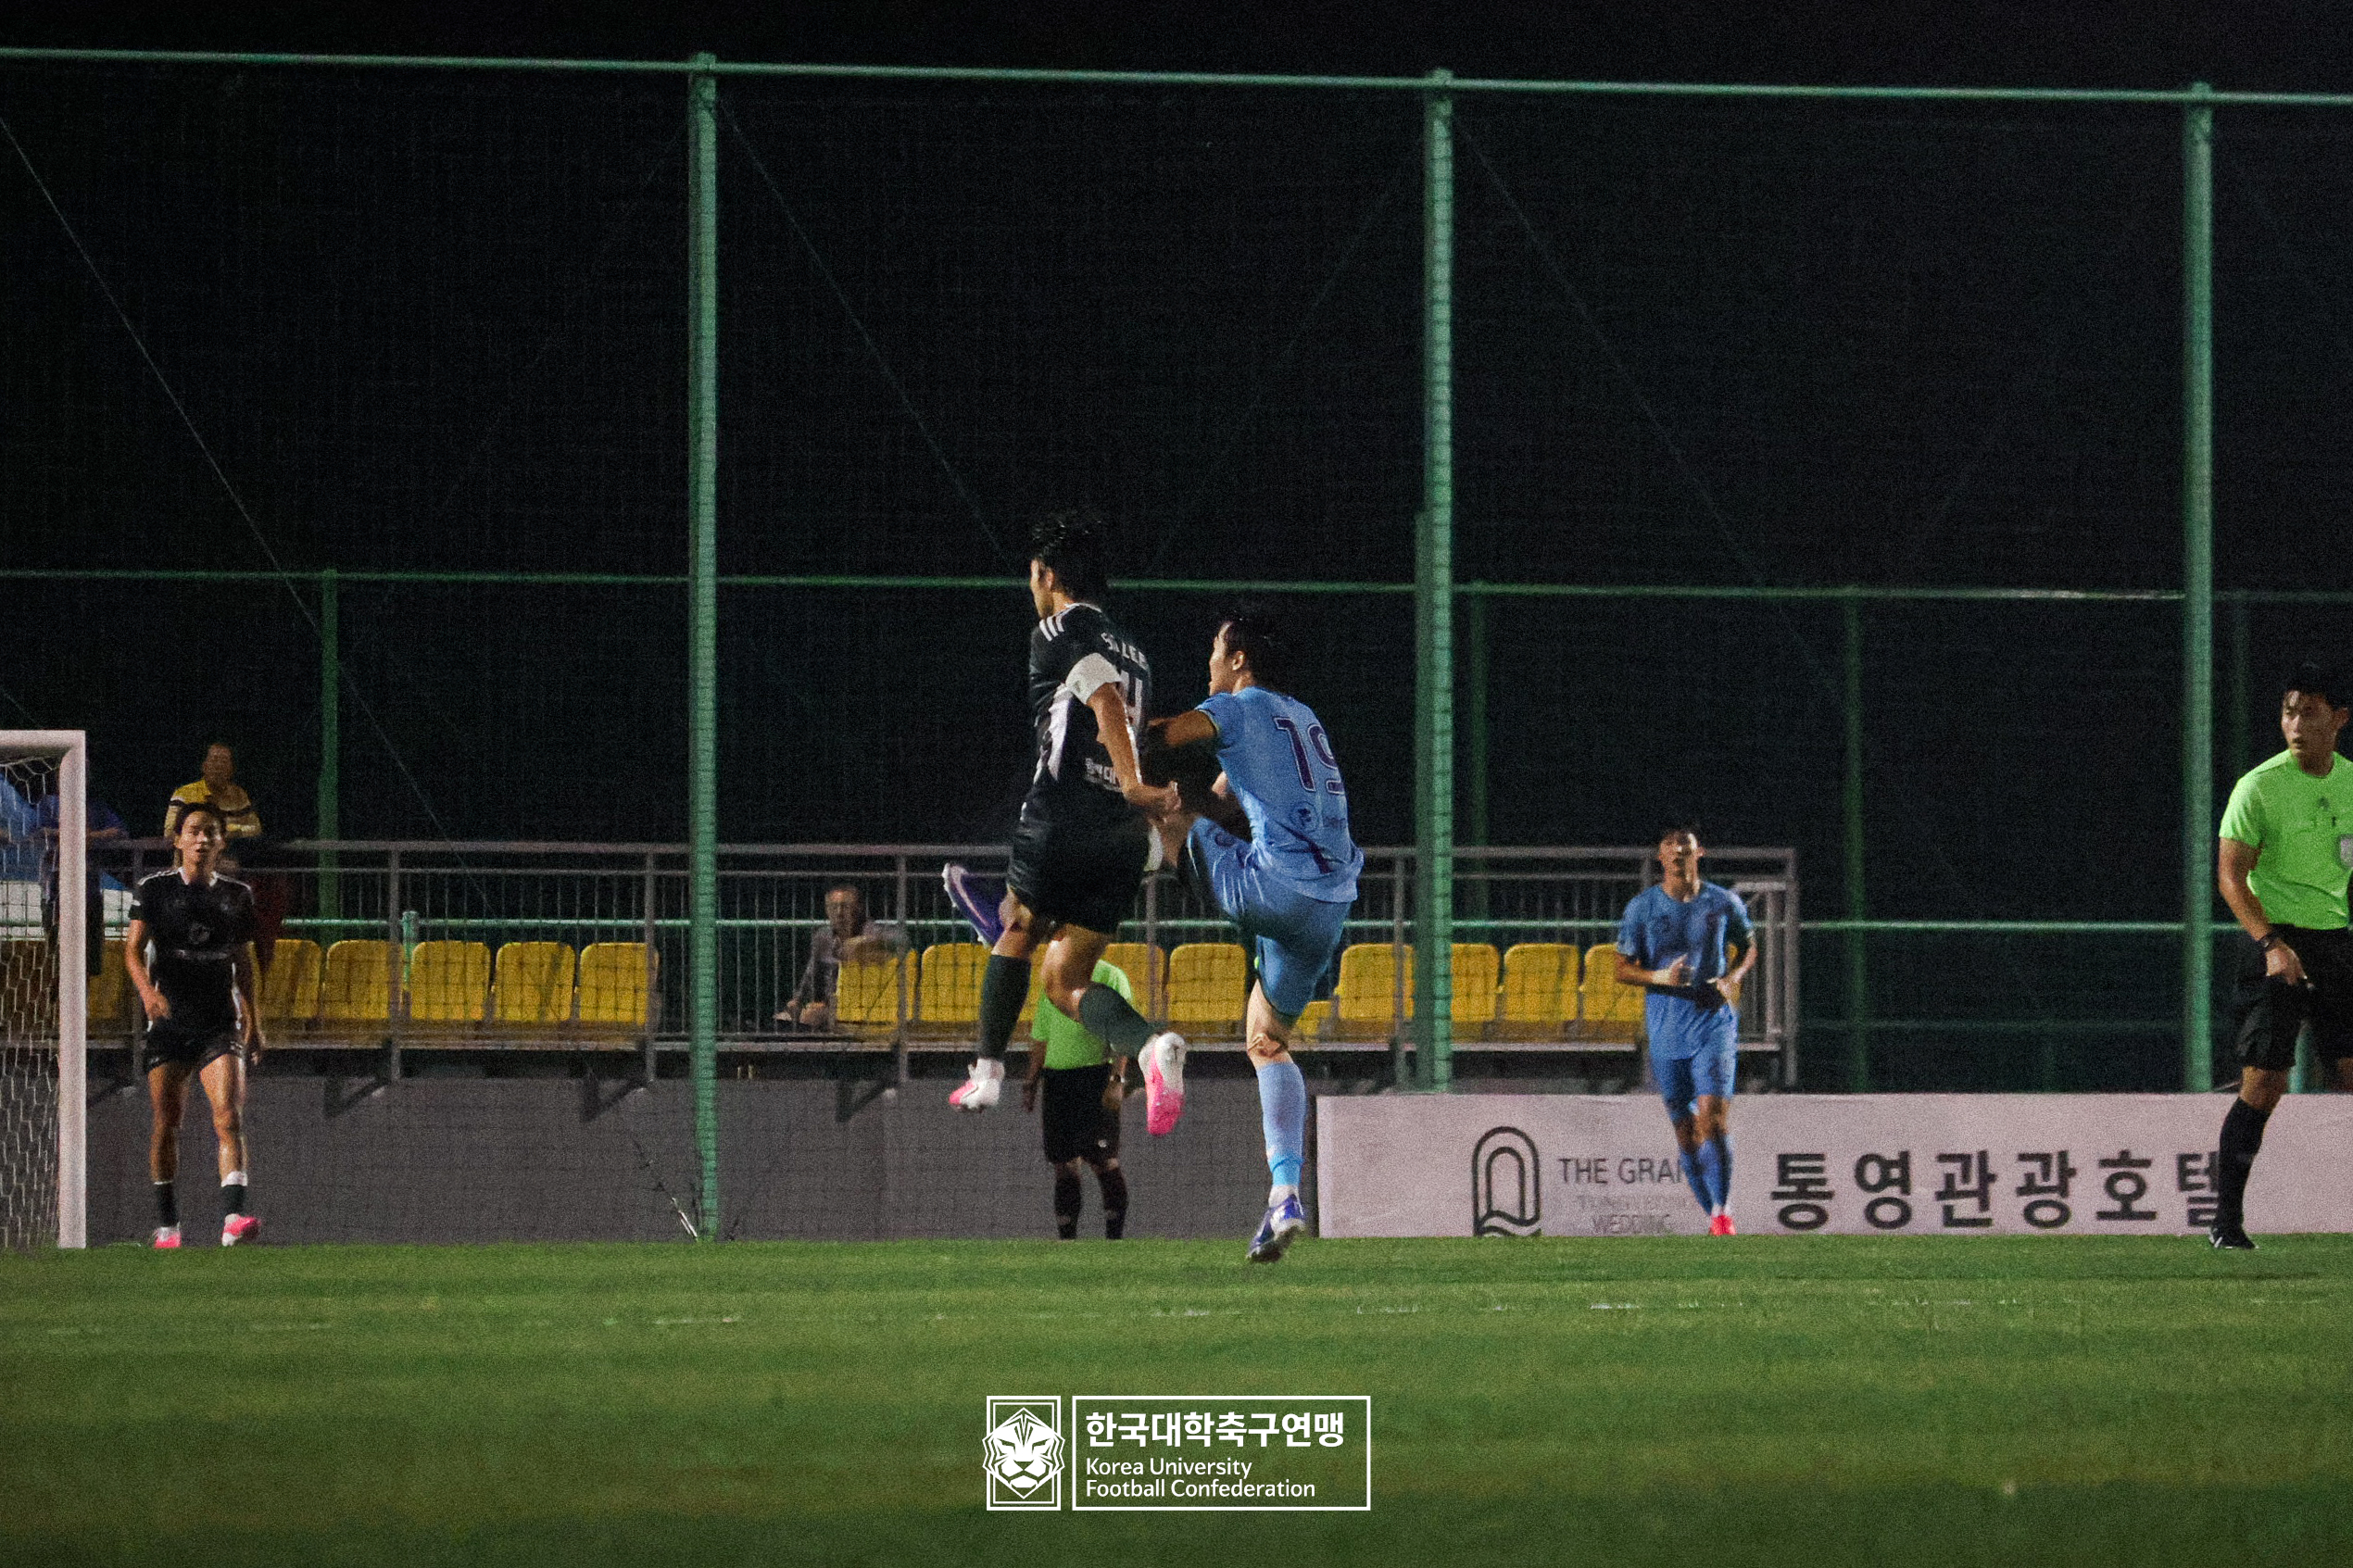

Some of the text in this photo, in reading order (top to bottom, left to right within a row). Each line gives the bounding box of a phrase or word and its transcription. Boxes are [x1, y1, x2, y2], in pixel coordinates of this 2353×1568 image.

[1272, 716, 1345, 795] 19
[1558, 1158, 1608, 1185] THE
[1770, 1148, 2221, 1230] 통영관광호텔
